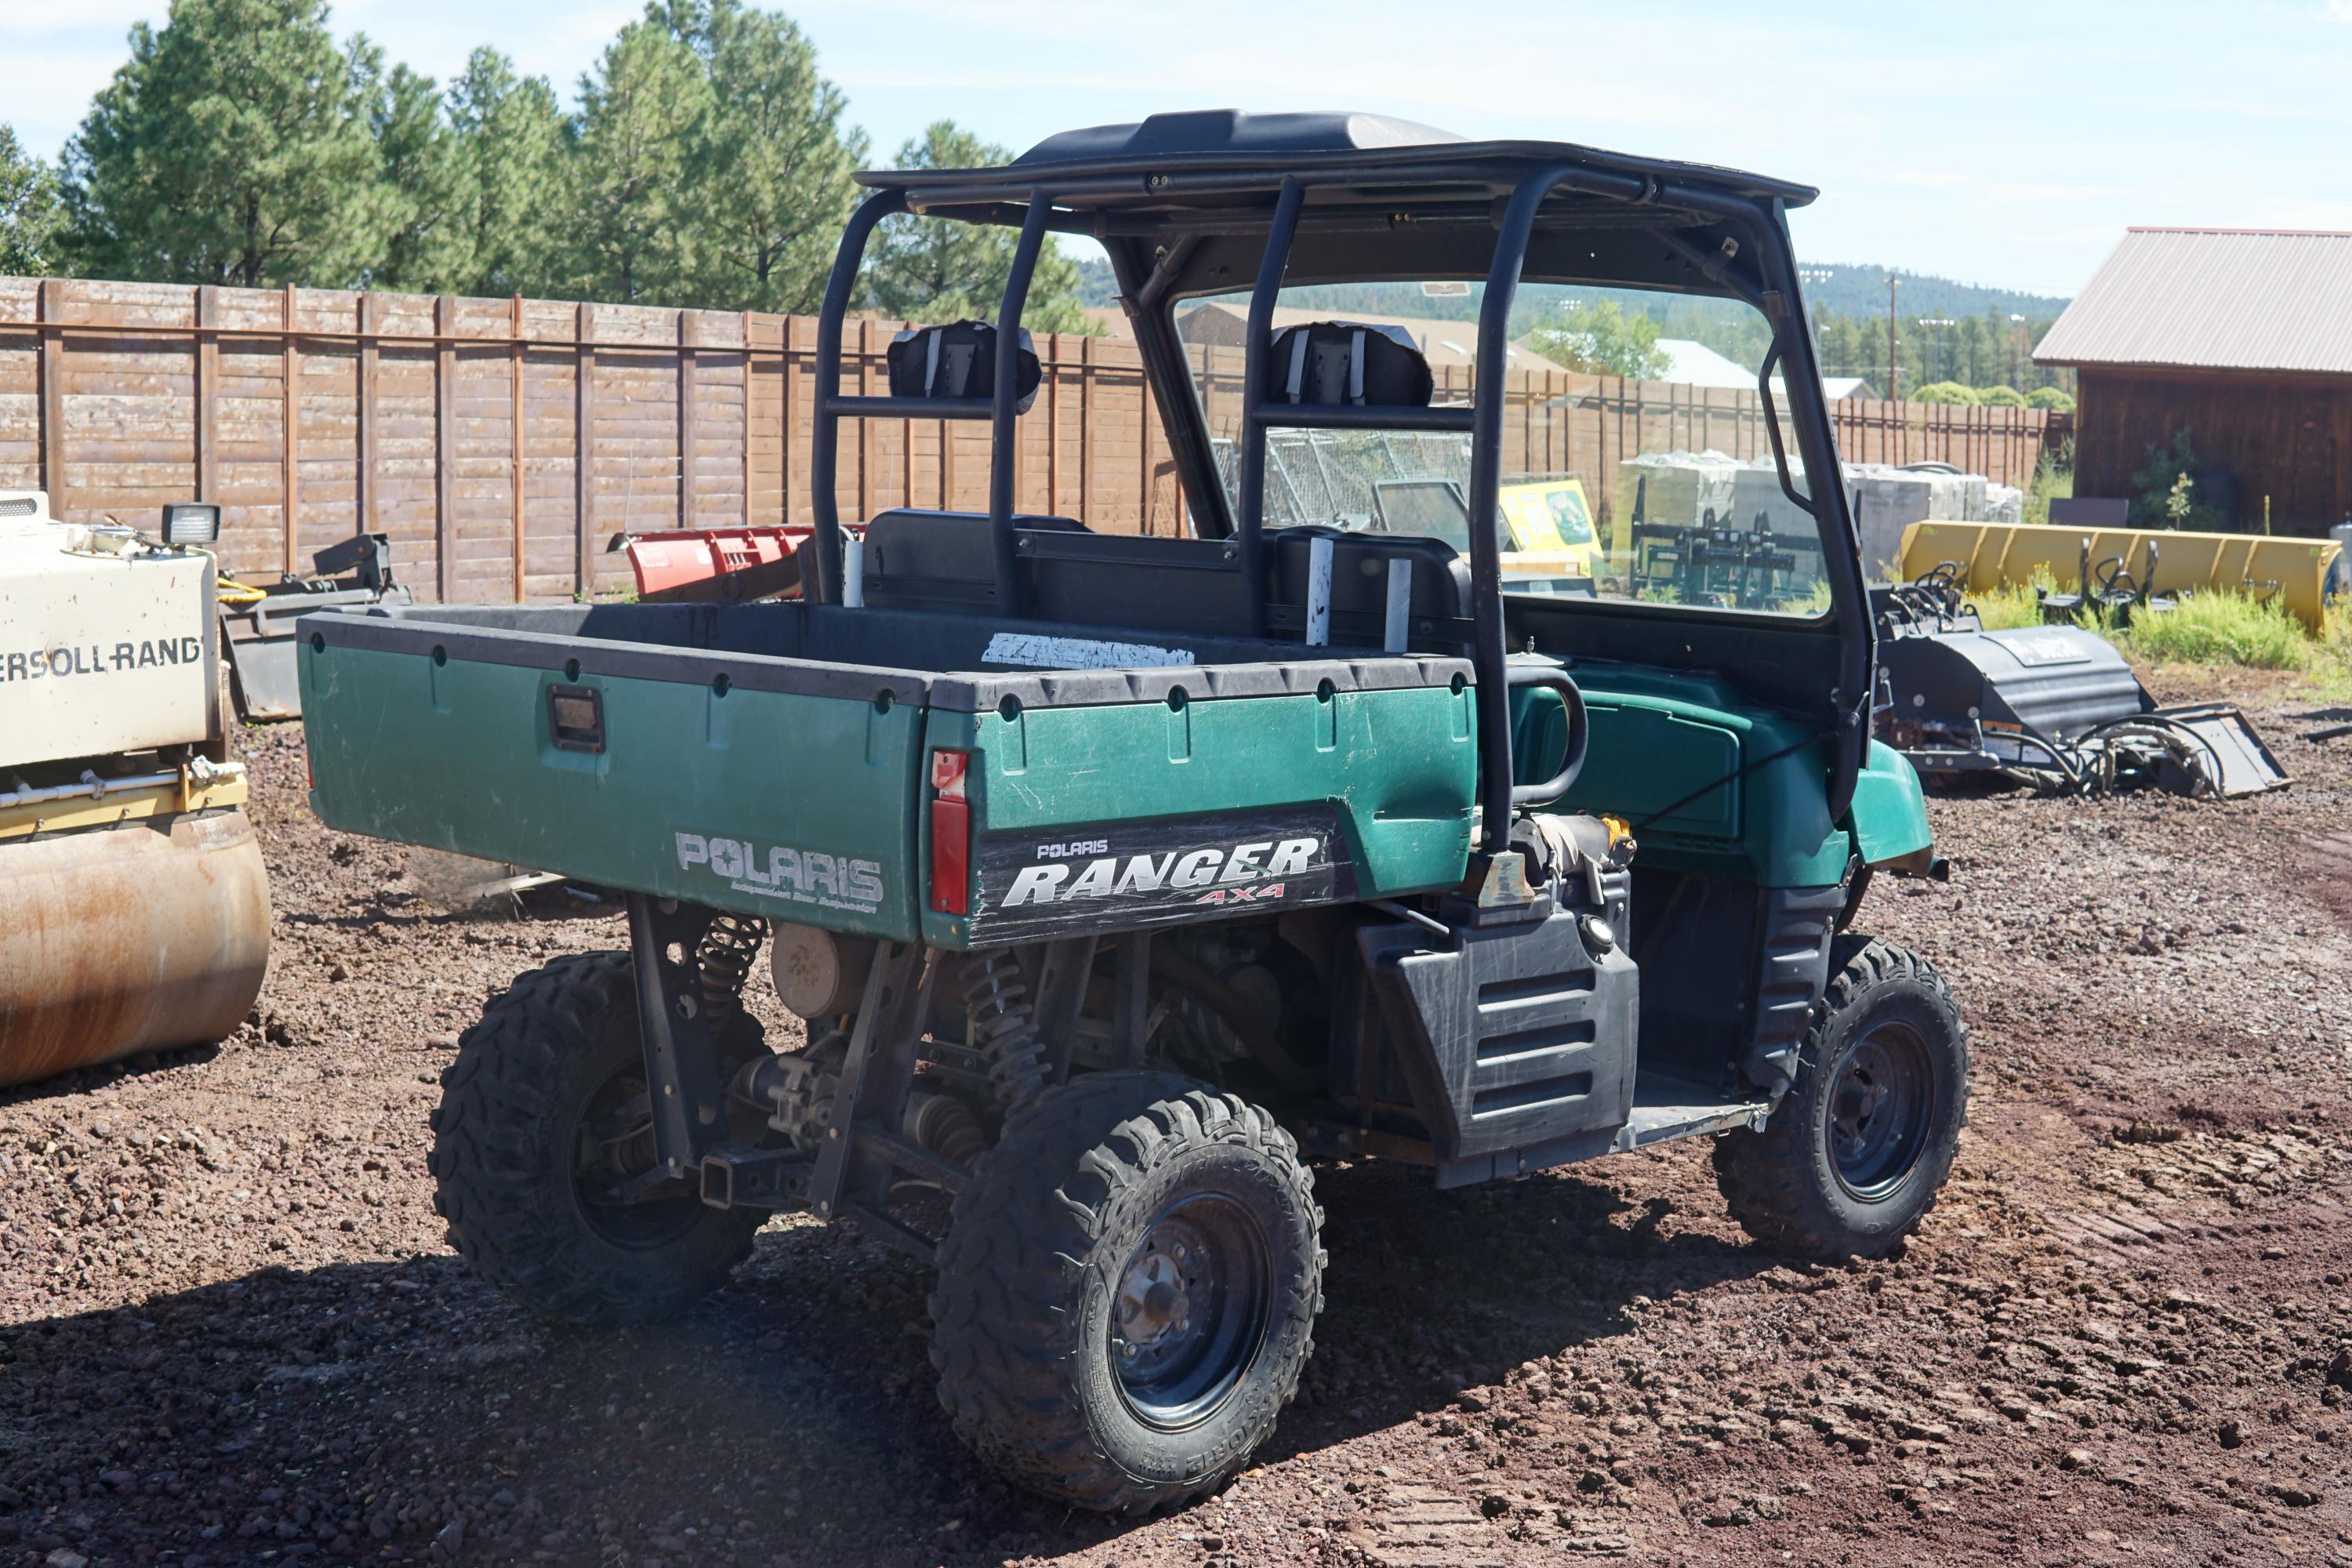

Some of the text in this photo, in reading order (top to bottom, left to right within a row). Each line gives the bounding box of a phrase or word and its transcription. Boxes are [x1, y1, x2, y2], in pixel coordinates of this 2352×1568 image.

[0, 637, 201, 682] RSOLL-RAND
[675, 831, 884, 902] POLARIS
[1000, 837, 1319, 907] RANGER
[1036, 839, 1108, 859] POLARIS
